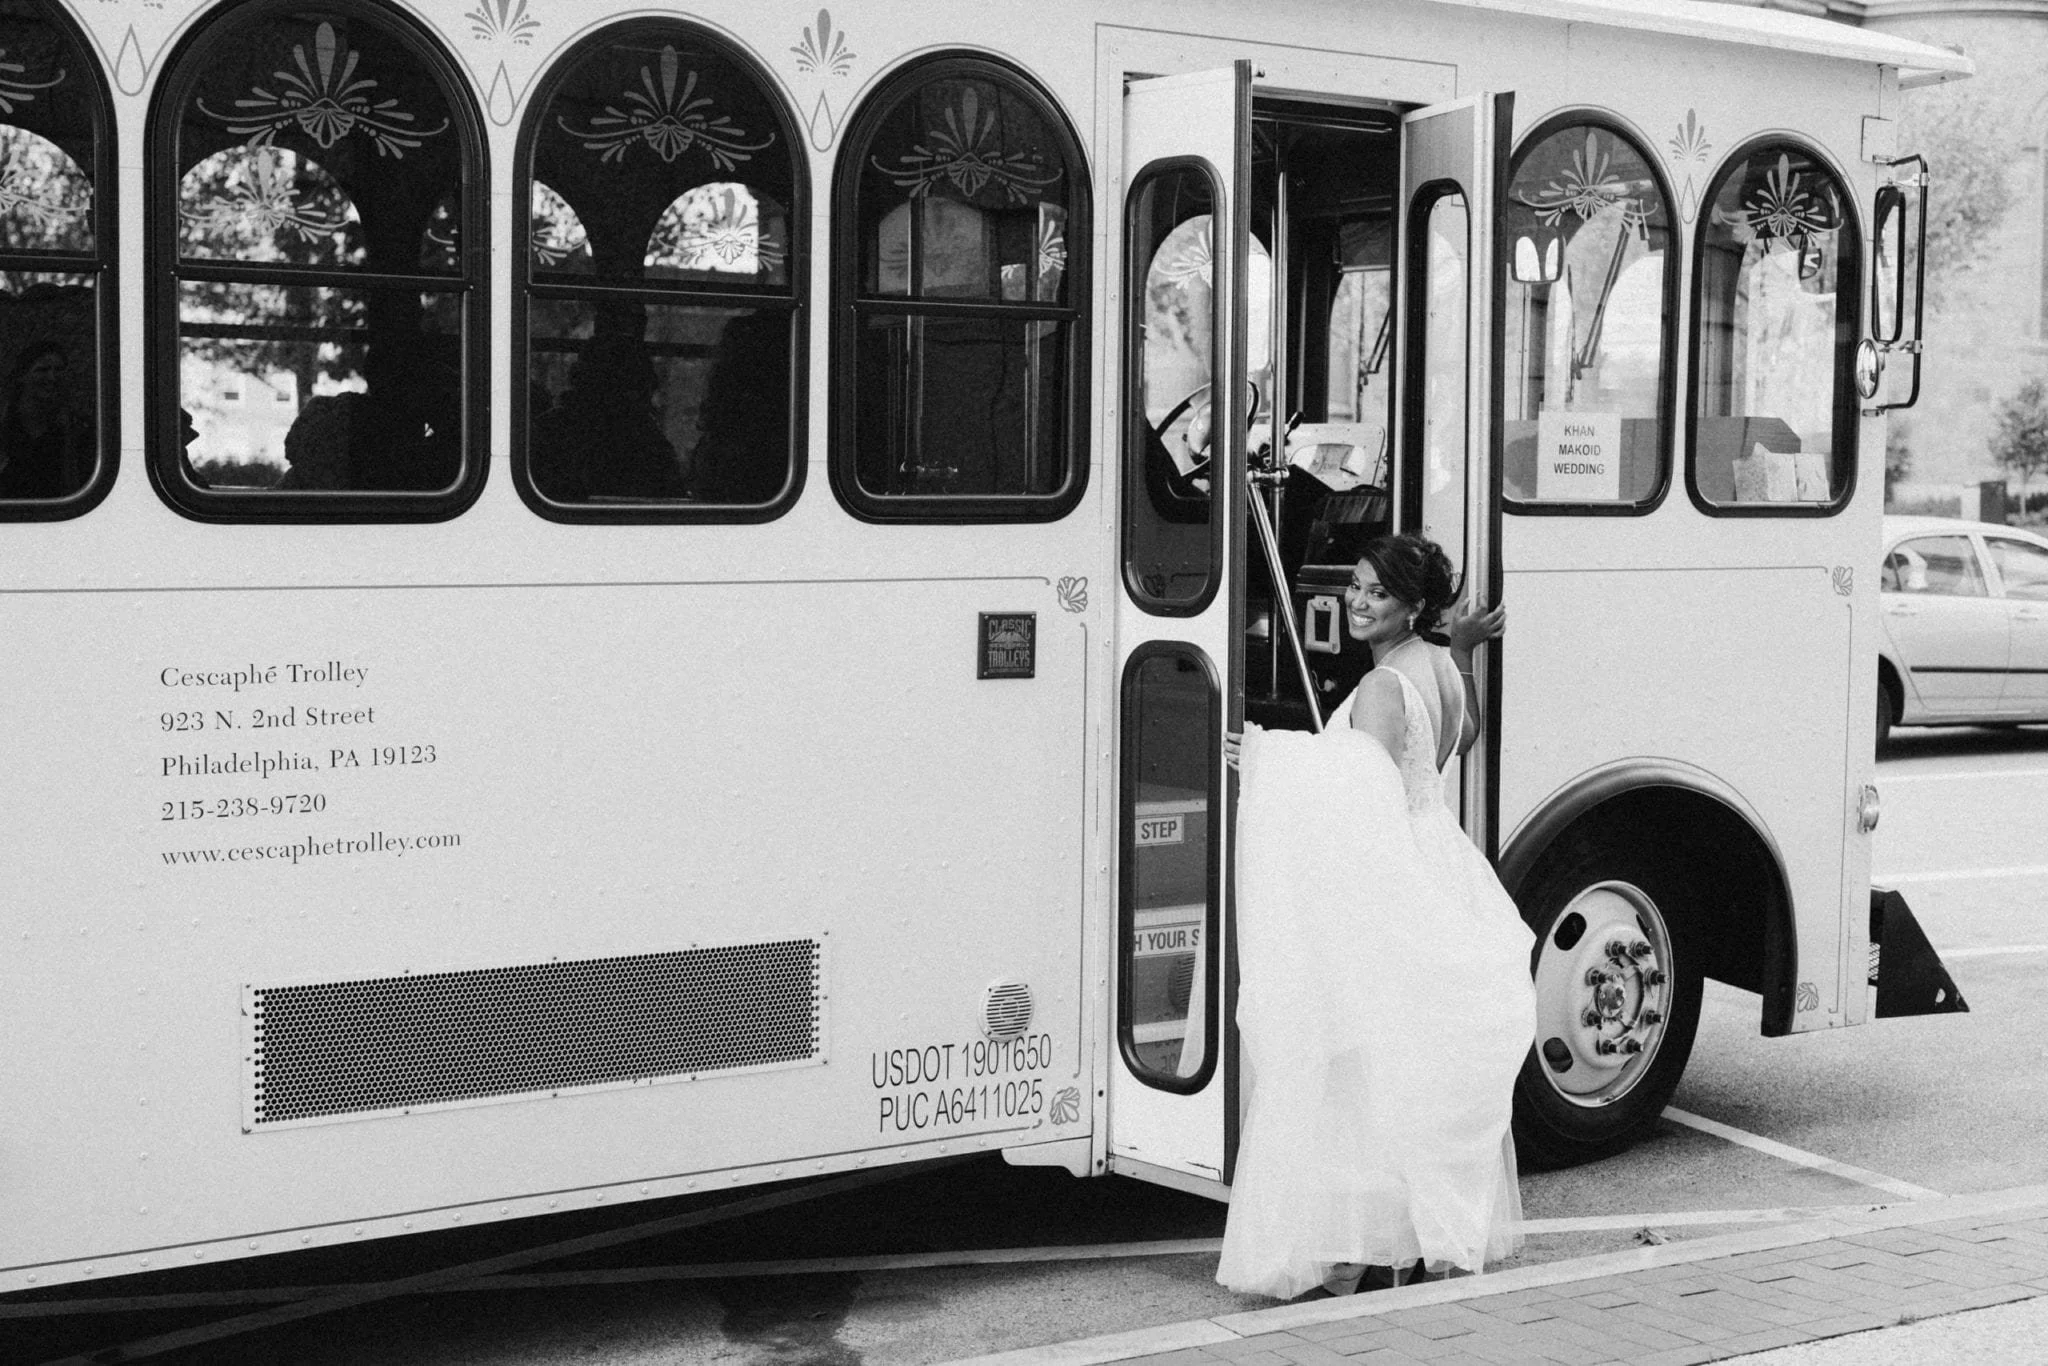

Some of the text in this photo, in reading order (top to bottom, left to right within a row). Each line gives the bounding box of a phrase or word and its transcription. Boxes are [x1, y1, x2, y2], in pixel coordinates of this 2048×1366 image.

[1564, 425, 1595, 437] KHAN
[1558, 444, 1601, 456] MAKOID
[1553, 463, 1605, 475] WEDDING
[988, 618, 1032, 641] CLASSIC
[988, 649, 1030, 668] TROLLEYS
[160, 661, 369, 692] Cescaphé Trolley
[160, 706, 376, 732] 923 N. 2nd Street
[161, 744, 437, 779] Philadelphia, PA 19123
[161, 793, 327, 821] 215-238-9720
[1141, 820, 1177, 840] STEP
[161, 831, 461, 865] www.cescaphetrolley.com
[1147, 930, 1187, 951] YOUR
[872, 1033, 1052, 1089] USDOT 1901650
[879, 1078, 1043, 1133] PUC A6411025
